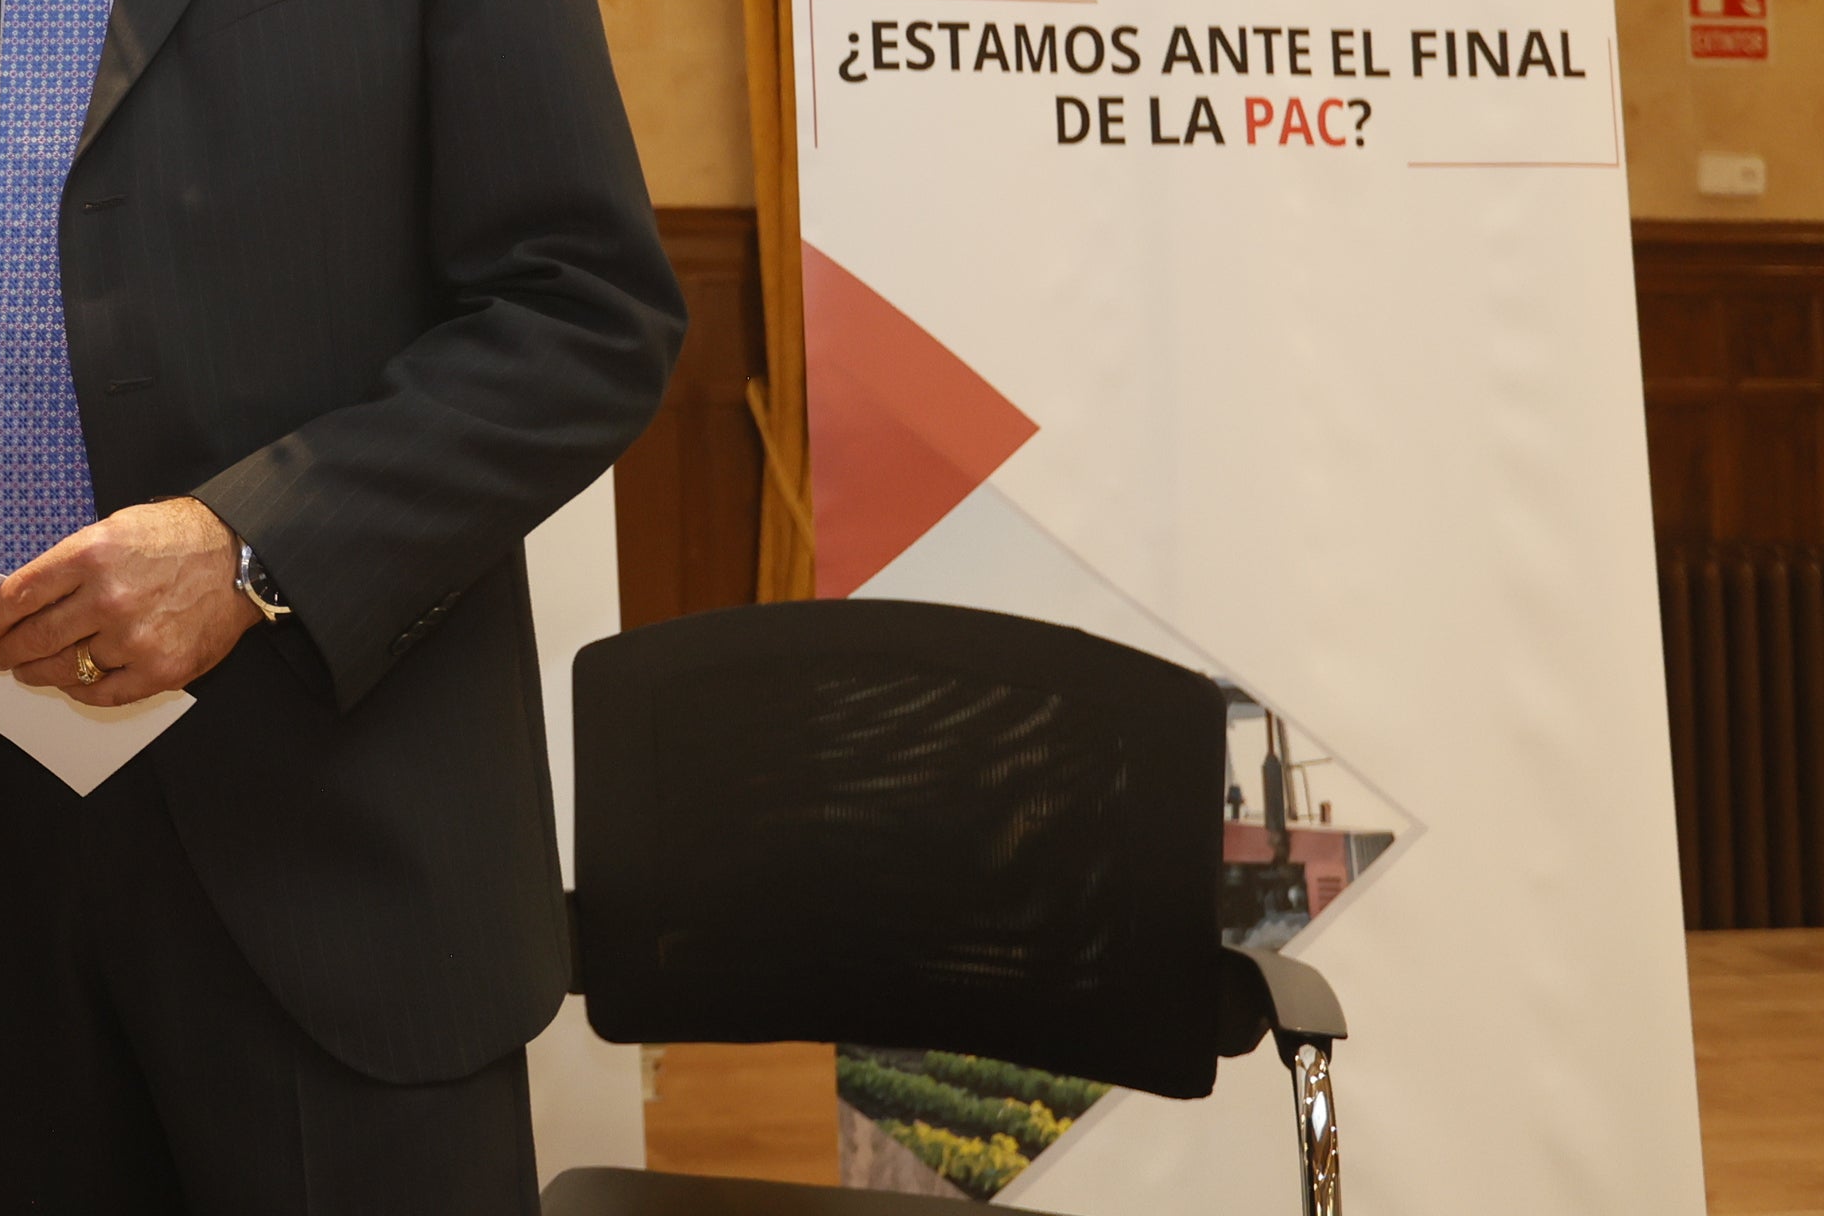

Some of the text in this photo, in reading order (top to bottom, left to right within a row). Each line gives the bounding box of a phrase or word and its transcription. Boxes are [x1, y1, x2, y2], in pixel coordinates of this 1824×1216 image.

[838, 20, 1587, 84] ¿ESTAMOS ANTE EL FINAL
[1055, 95, 1373, 148] DE LA PAC?
